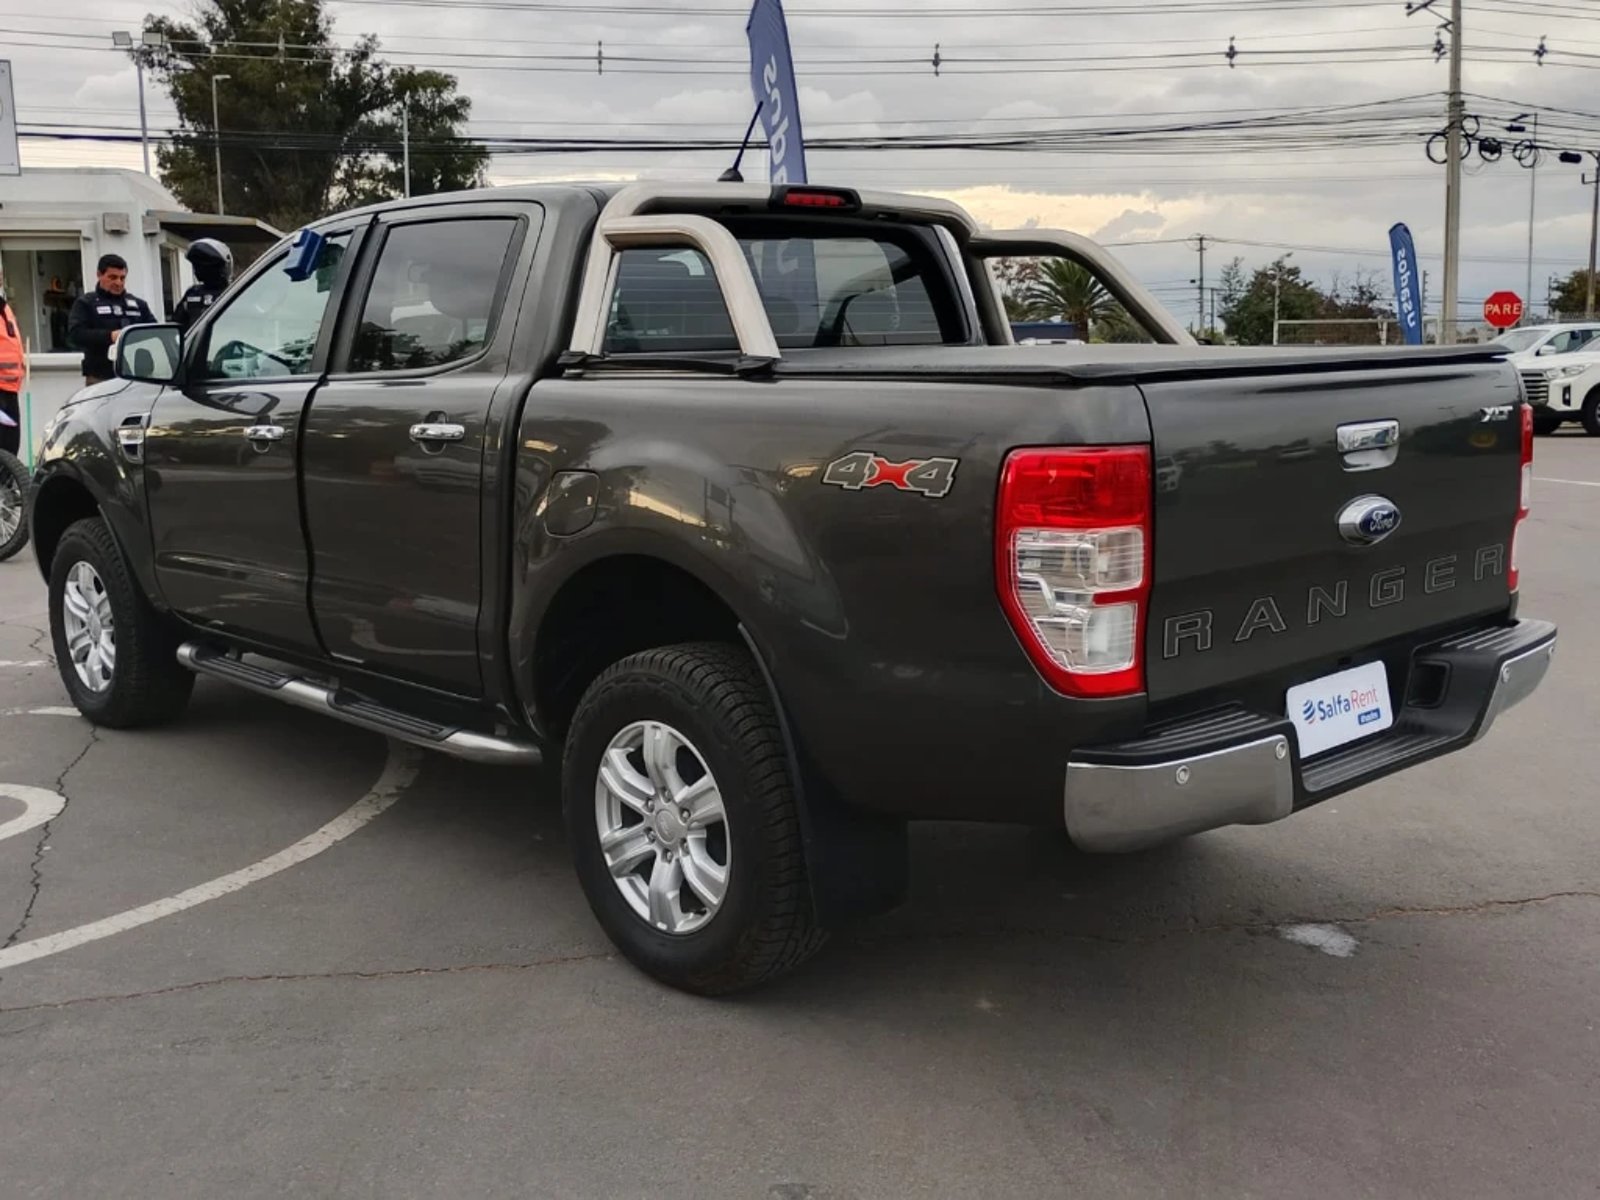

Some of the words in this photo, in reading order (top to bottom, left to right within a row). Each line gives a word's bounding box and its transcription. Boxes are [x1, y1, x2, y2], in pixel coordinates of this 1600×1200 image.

[1485, 303, 1521, 316] PARE
[1370, 510, 1396, 532] Ford
[1162, 543, 1505, 660] RANGER
